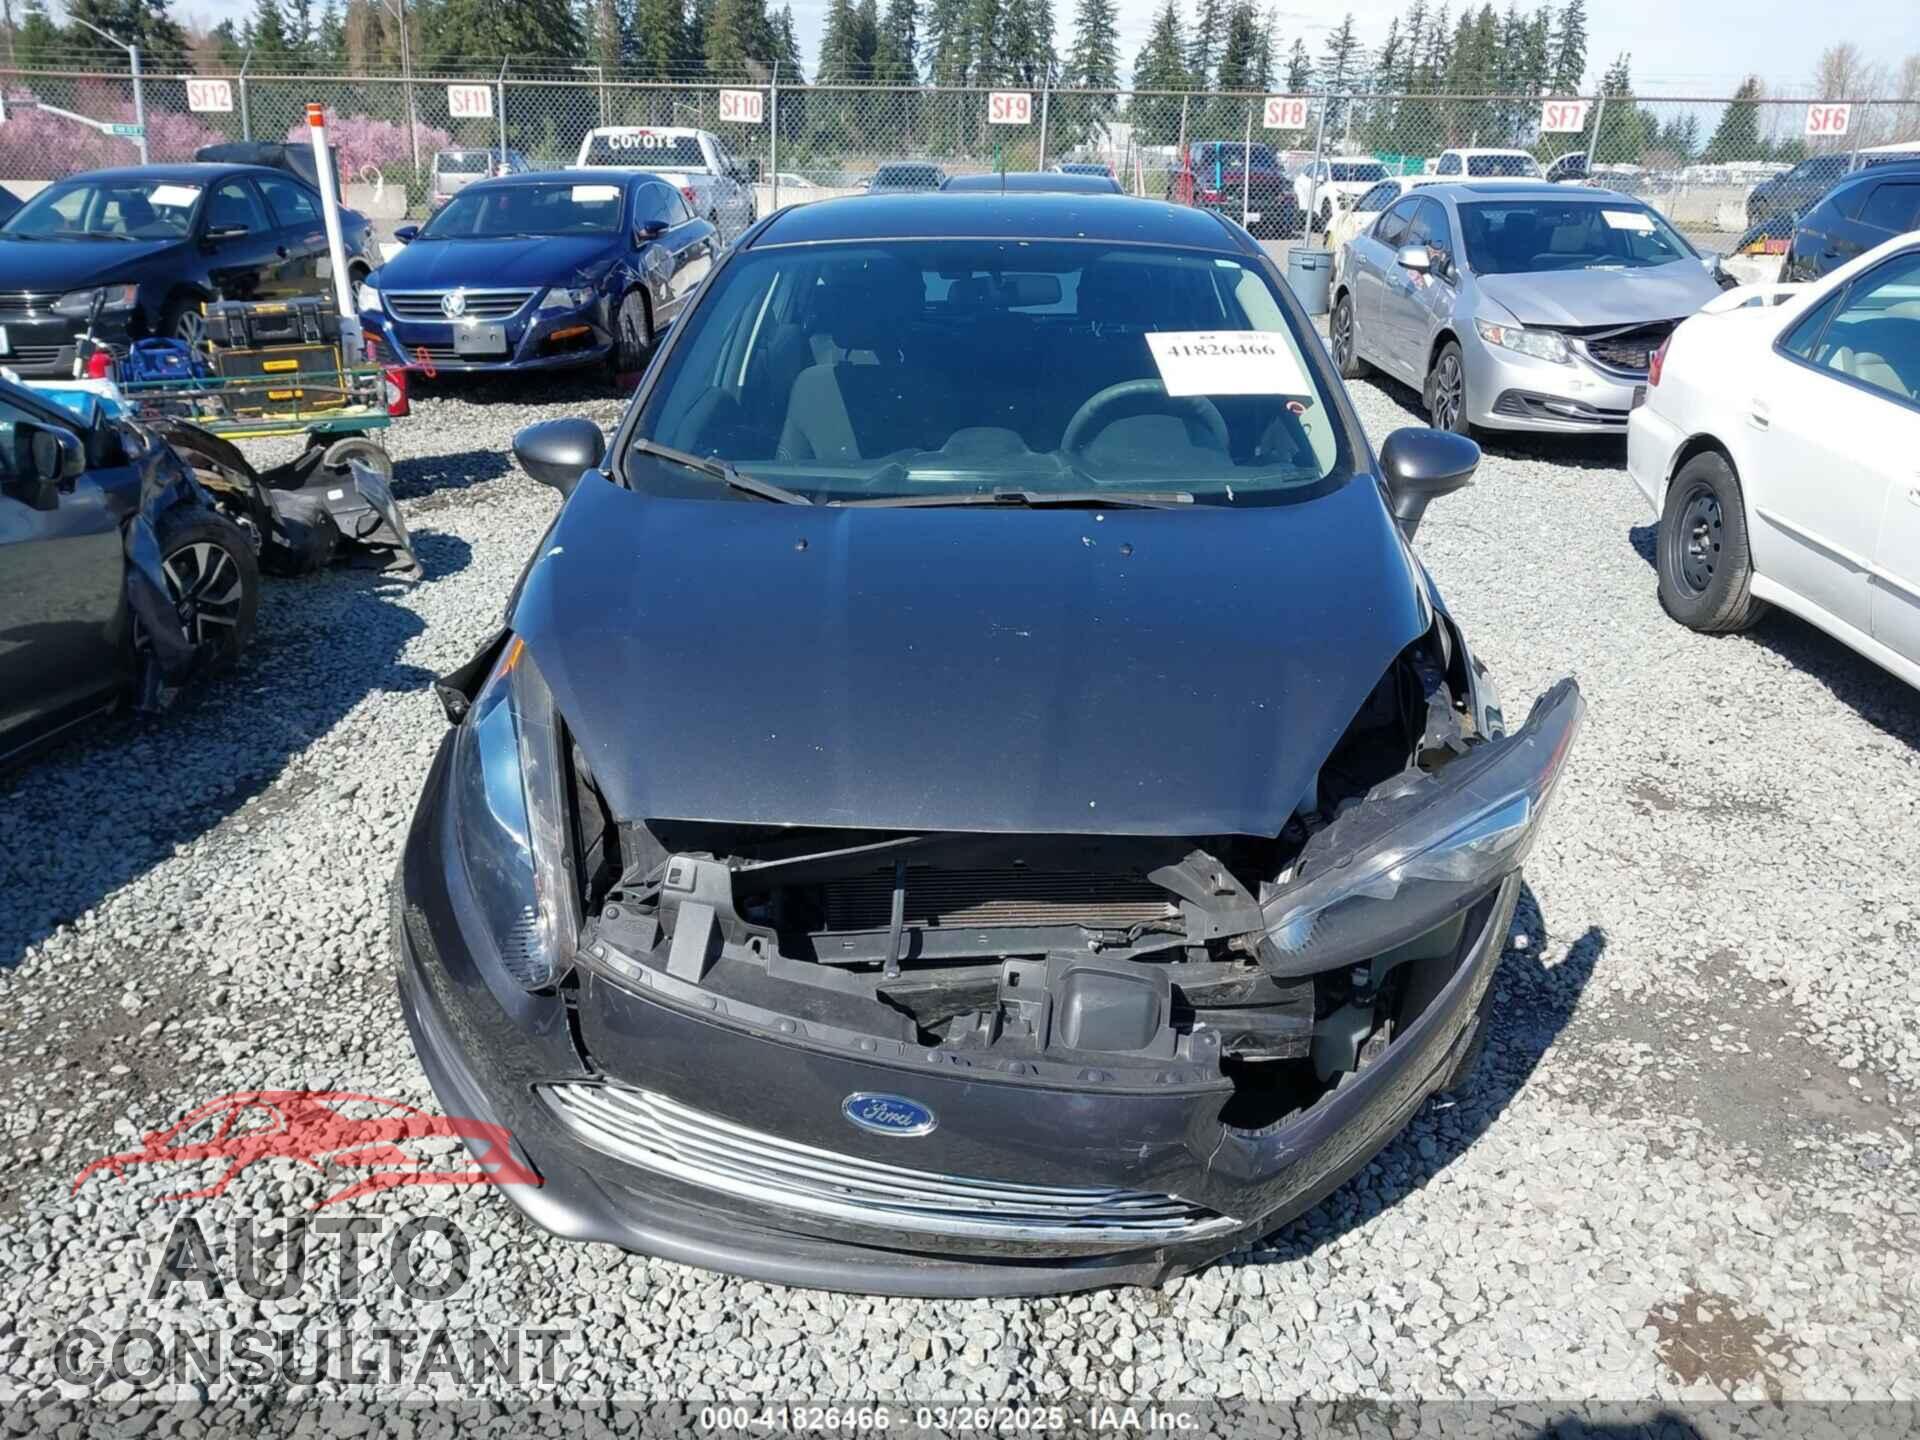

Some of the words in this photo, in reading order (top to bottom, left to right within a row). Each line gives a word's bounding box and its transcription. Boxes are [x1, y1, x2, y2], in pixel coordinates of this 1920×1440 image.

[190, 83, 229, 107] SF12
[452, 89, 487, 112] SF11
[722, 94, 760, 118] SF10
[992, 96, 1028, 119] SF9
[1268, 101, 1303, 125] SF8
[1546, 104, 1581, 128] SF7
[1809, 107, 1847, 131] SF6
[608, 134, 677, 149] COYOTE
[1168, 344, 1275, 357] 41826466
[863, 1103, 915, 1127] Ford
